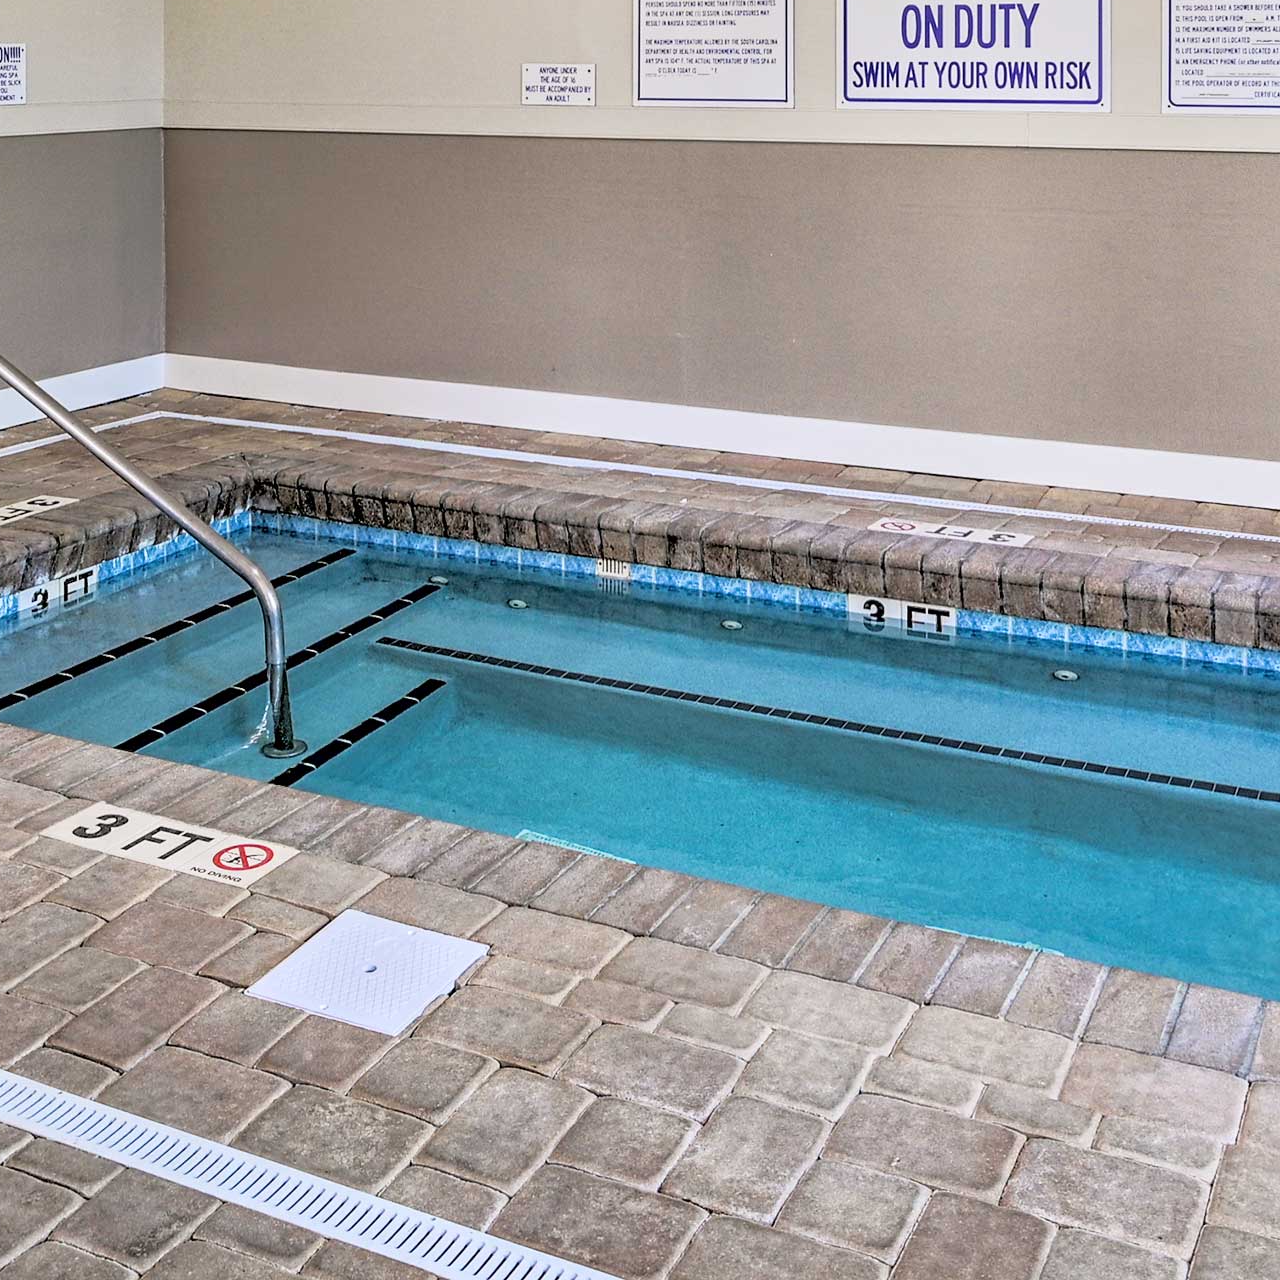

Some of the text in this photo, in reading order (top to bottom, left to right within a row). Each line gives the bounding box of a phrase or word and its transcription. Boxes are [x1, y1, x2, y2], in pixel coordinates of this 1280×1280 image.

[902, 3, 1040, 49] ON DUTY
[853, 62, 1091, 89] SWIM AT YOUR OWN RISK
[27, 499, 60, 507] 3
[926, 526, 1016, 542] 3 FT
[32, 570, 93, 612] 3 FT
[863, 600, 950, 632] 3 FT
[72, 814, 214, 860] 3 FT
[190, 866, 242, 882] NO DIVING
